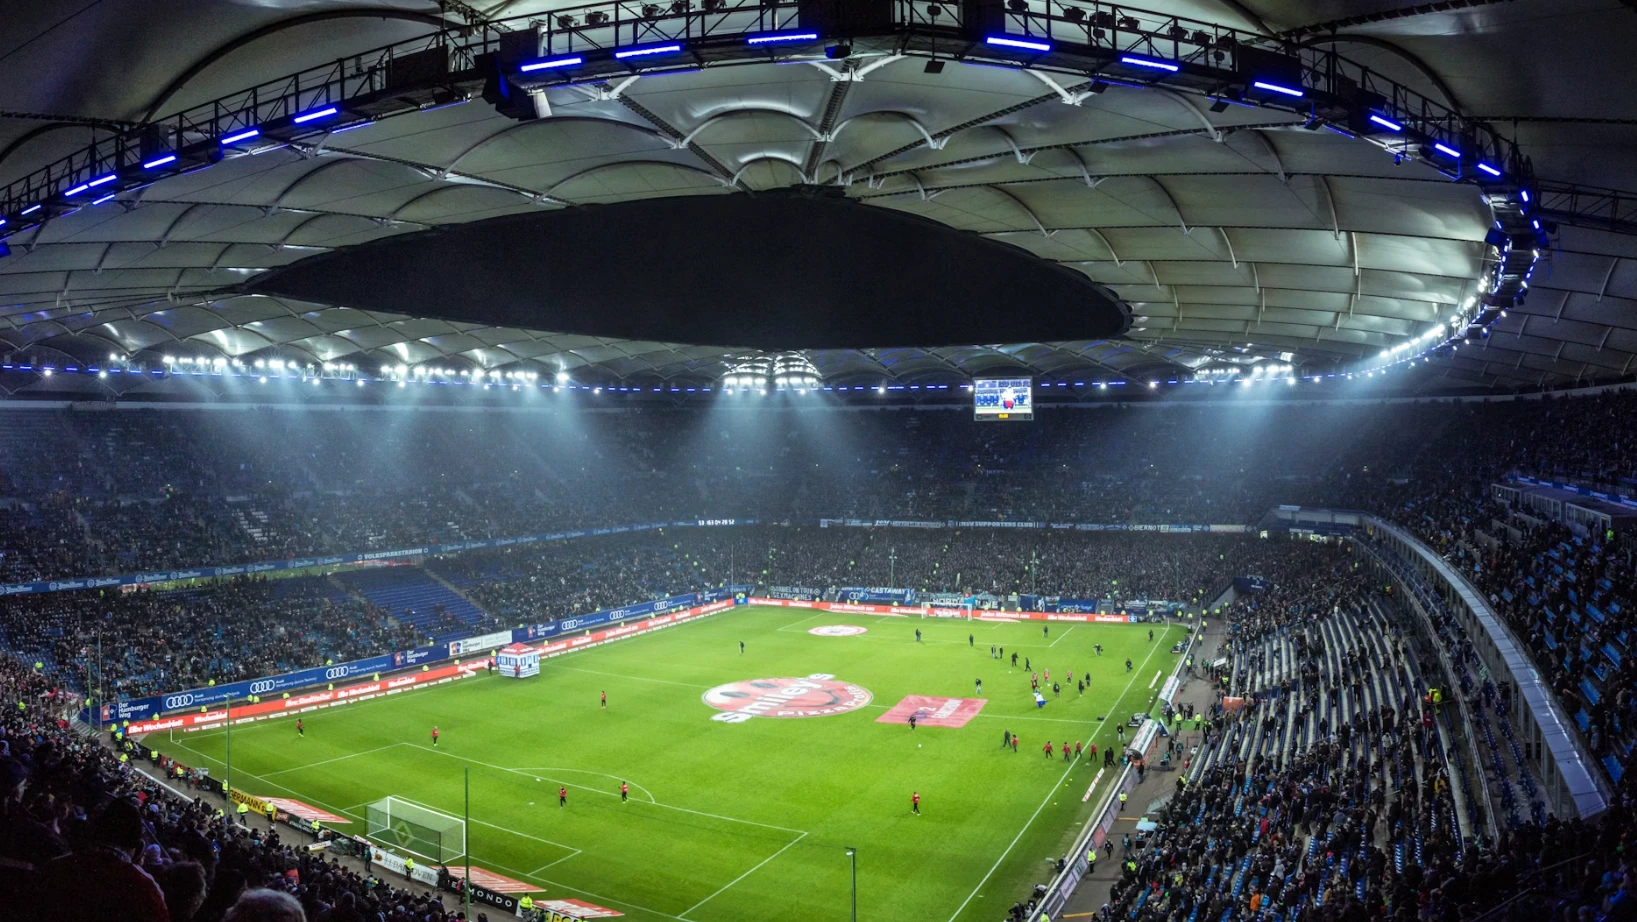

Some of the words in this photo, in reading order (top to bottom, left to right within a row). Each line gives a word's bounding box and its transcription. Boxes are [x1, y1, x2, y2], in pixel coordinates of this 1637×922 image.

[363, 548, 423, 560] VOLKSPARKSTADION
[870, 587, 905, 595] CASTAWAY
[406, 651, 429, 660] Hamburger
[194, 695, 214, 703] Vorsprung
[337, 690, 349, 699] Elbe
[118, 703, 149, 714] Hamburger
[118, 711, 131, 719] Weg
[194, 711, 228, 723] Wochenblat
[128, 724, 143, 734] Elbe
[143, 718, 183, 733] Wochenblatt
